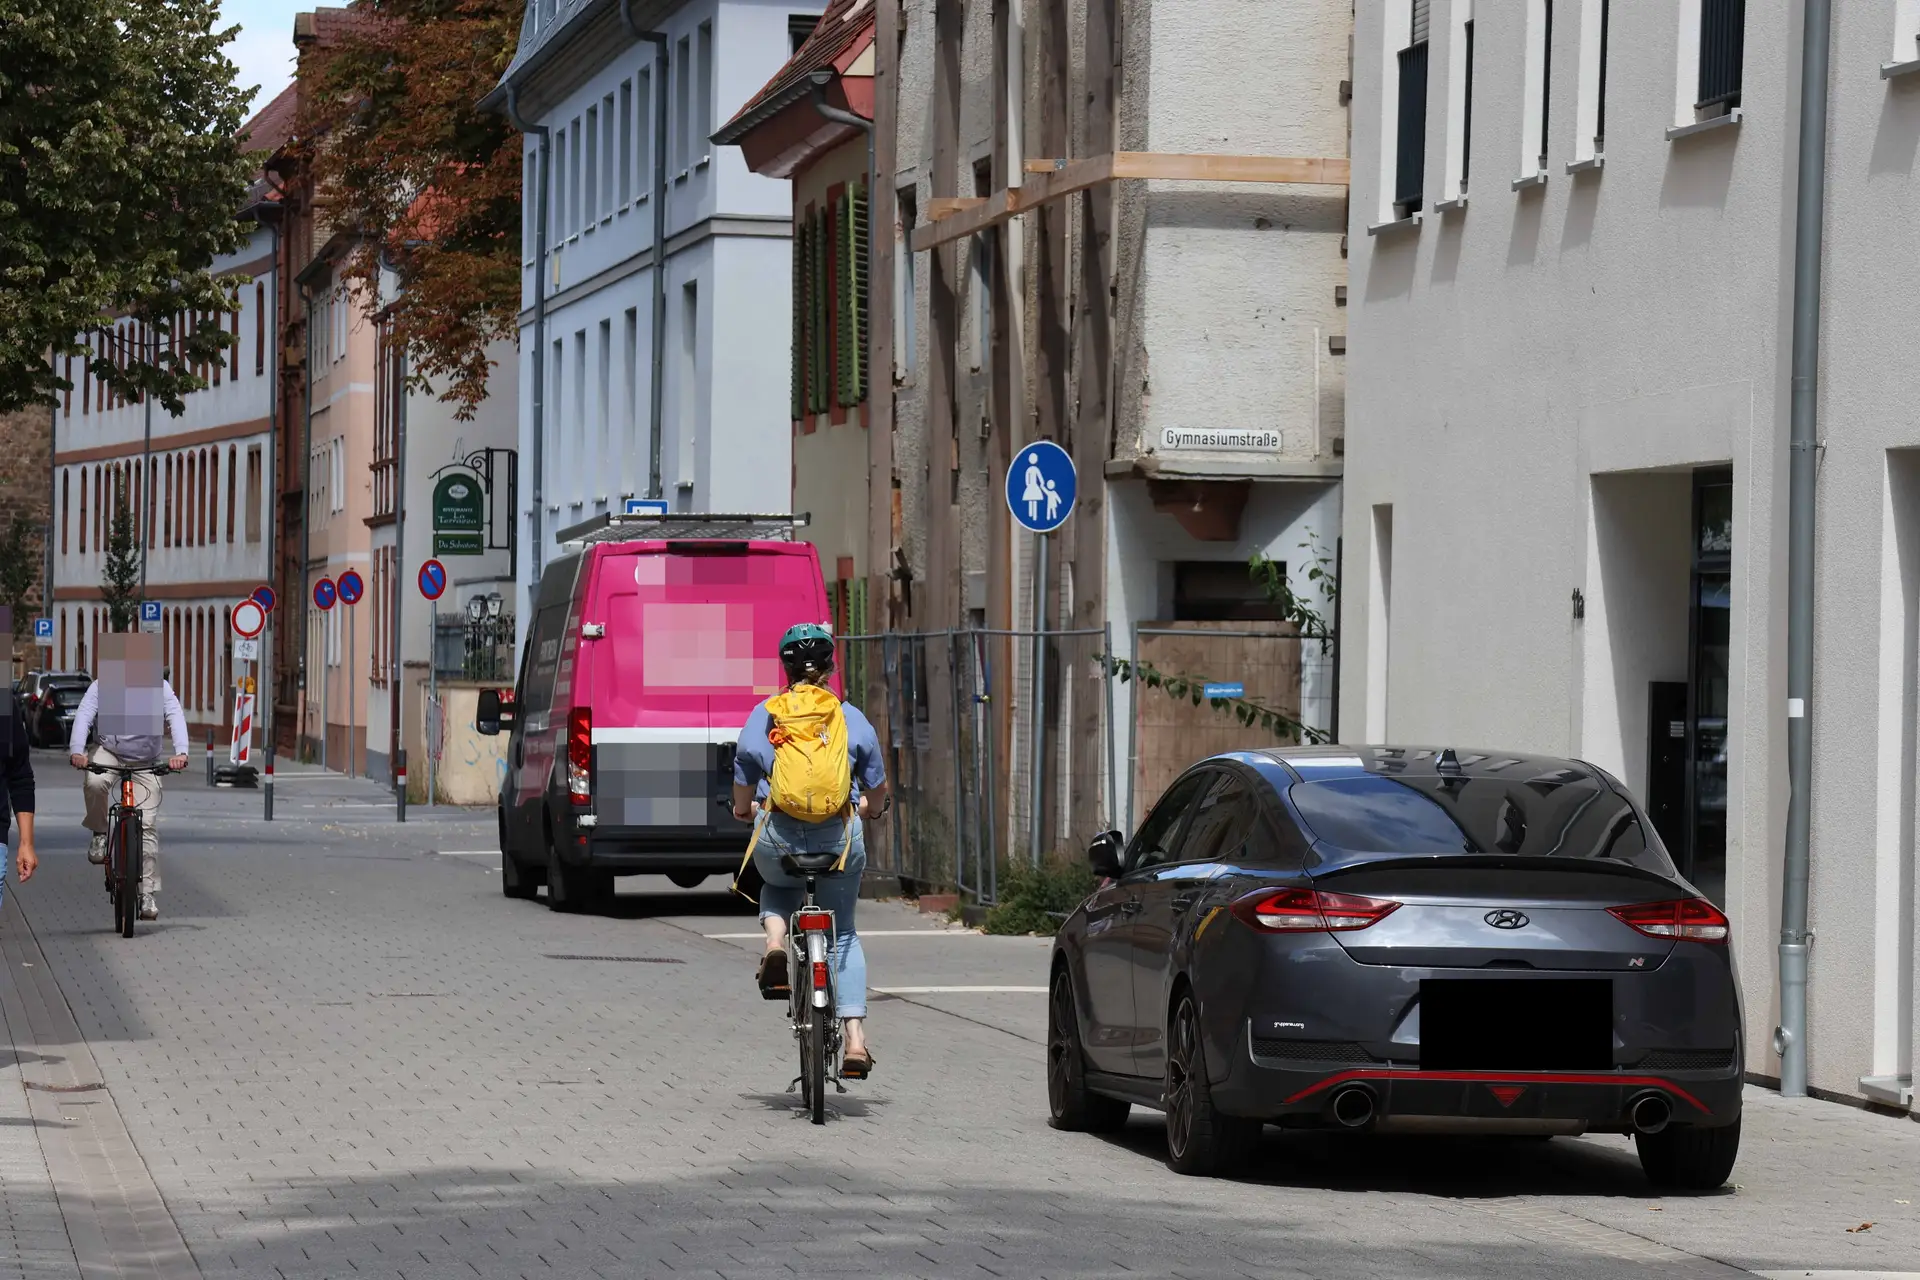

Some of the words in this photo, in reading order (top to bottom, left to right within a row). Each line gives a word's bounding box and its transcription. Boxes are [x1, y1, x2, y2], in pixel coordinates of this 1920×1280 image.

[1166, 430, 1278, 448] Gymnasiumstraße
[438, 540, 448, 548] Da
[449, 540, 478, 549] Salvatore
[145, 604, 157, 619] P
[39, 621, 49, 635] P
